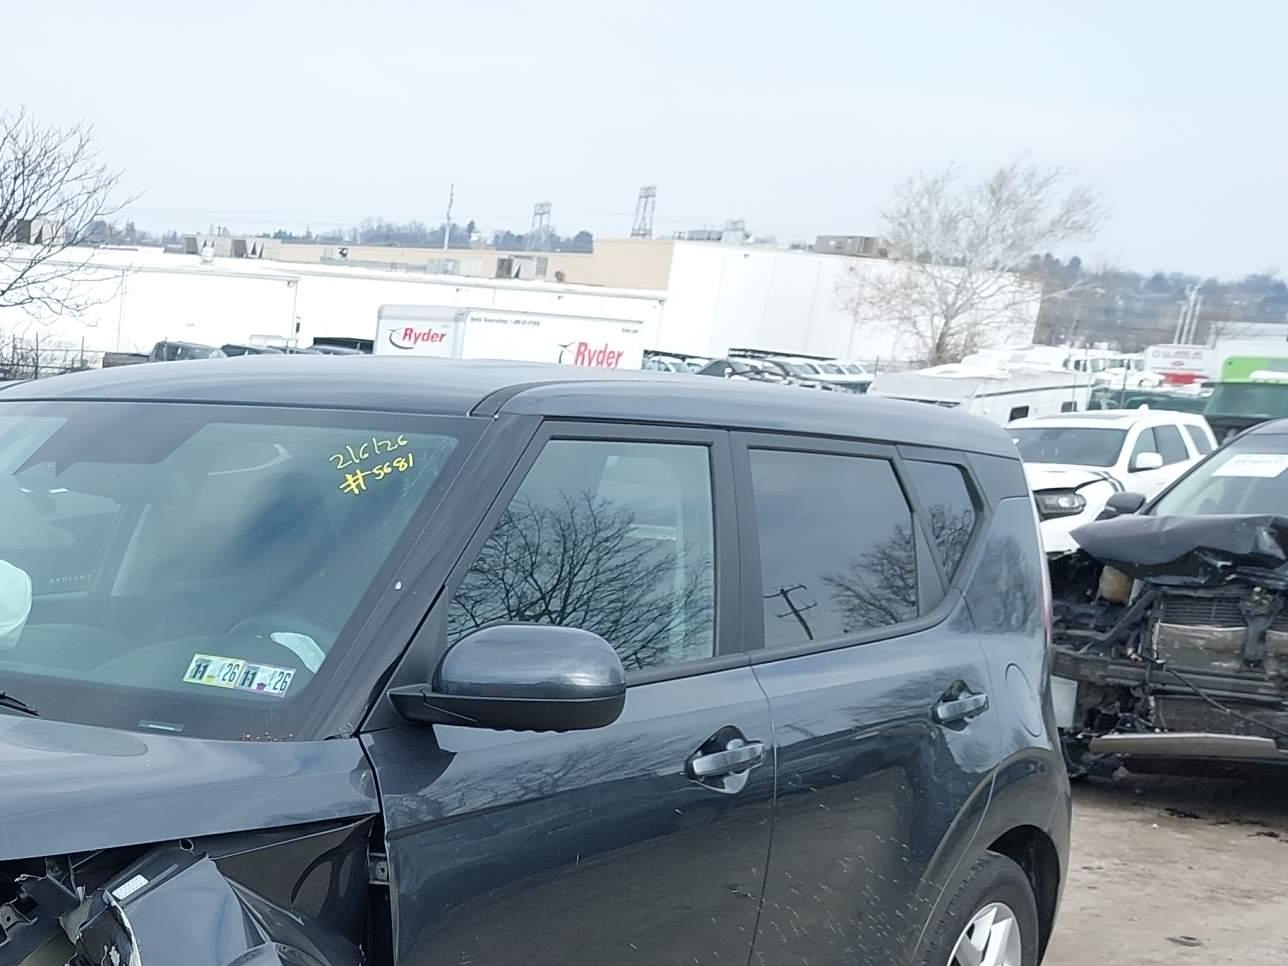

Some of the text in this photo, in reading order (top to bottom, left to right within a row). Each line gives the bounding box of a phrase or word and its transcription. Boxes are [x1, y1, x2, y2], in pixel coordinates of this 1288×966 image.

[402, 327, 446, 345] Ryder
[574, 342, 624, 368] Ryder
[221, 662, 241, 683] 26
[272, 671, 292, 692] 26
